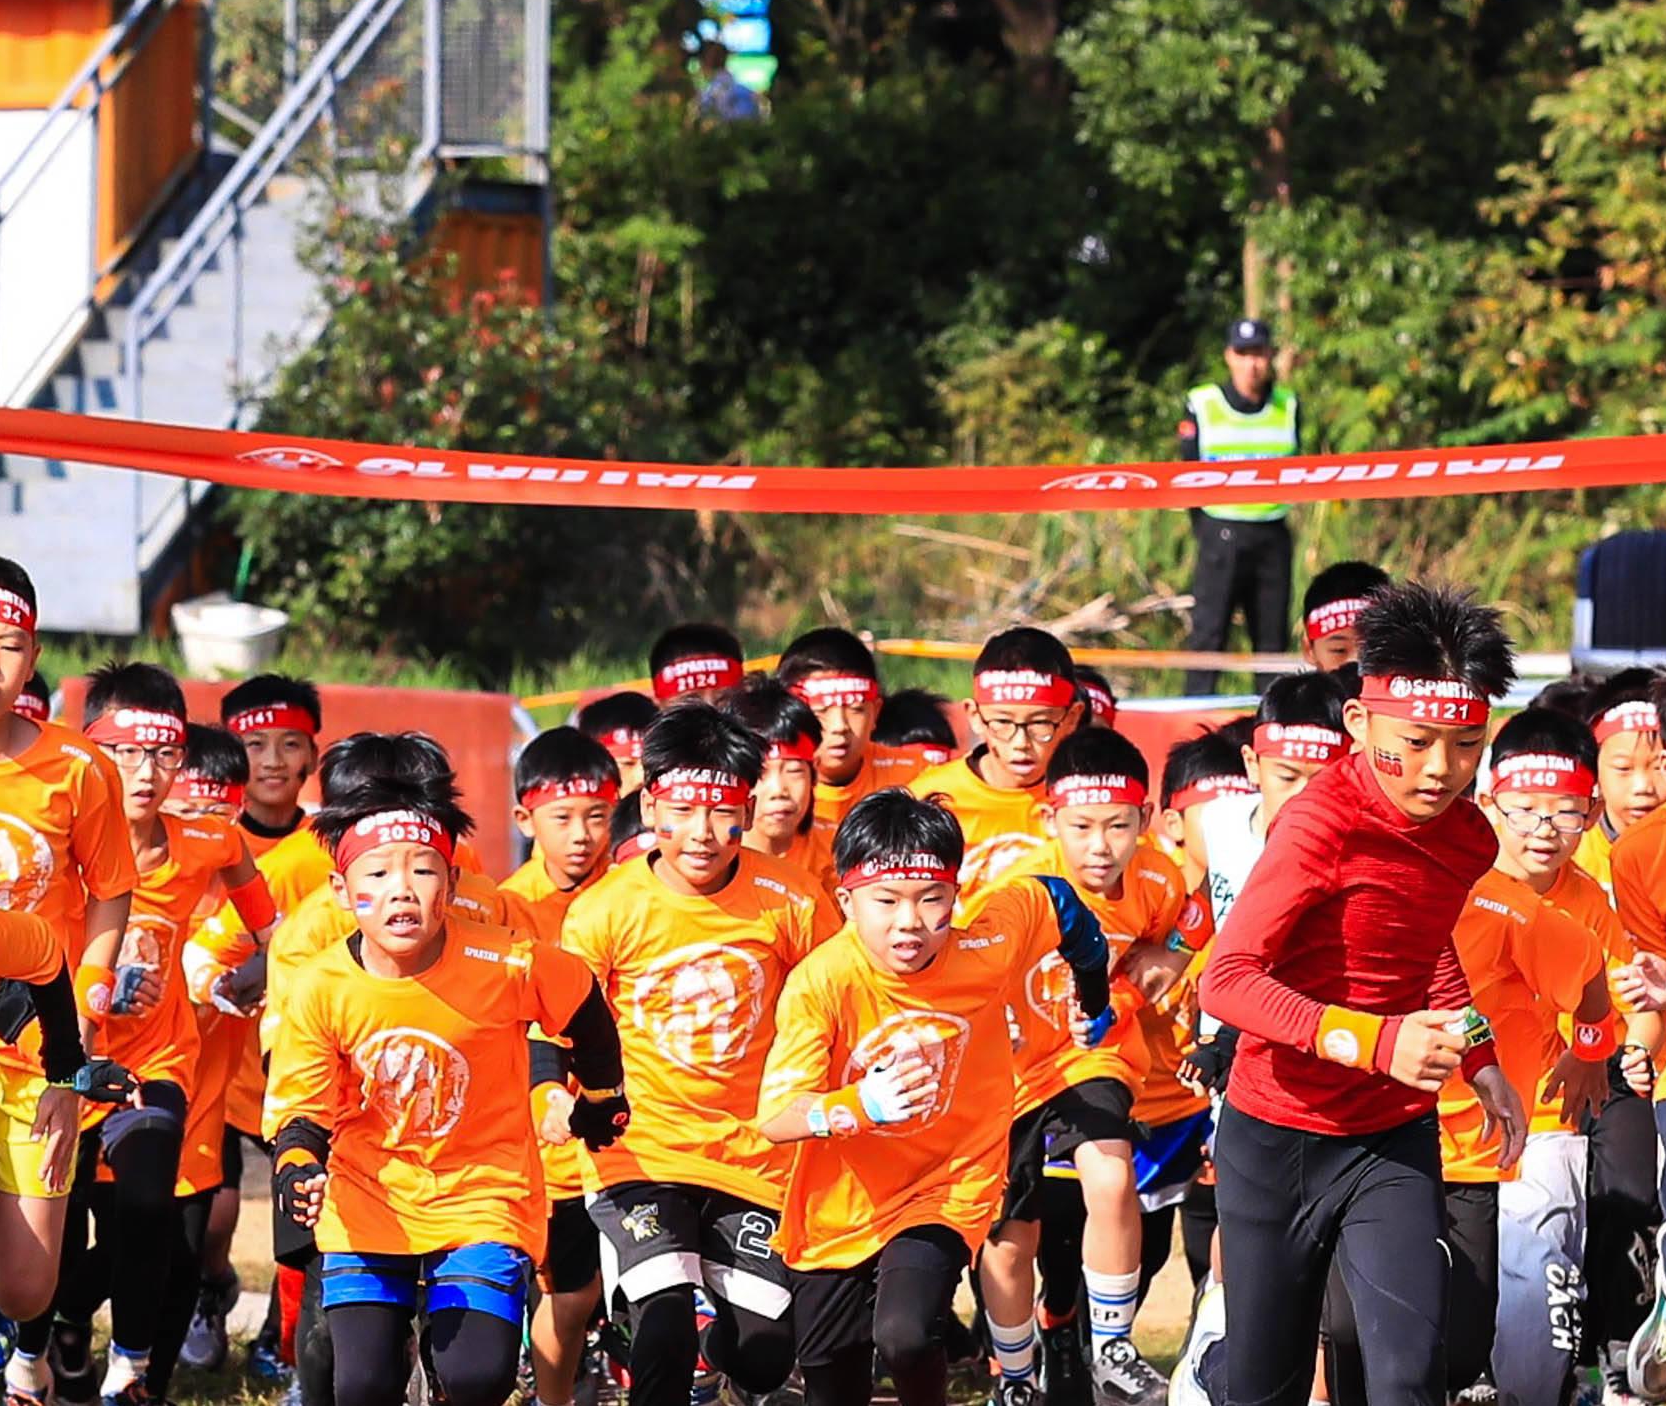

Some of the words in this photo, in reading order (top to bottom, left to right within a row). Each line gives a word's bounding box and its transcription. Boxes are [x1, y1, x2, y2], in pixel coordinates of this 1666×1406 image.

[1411, 700, 1470, 721] 2121
[670, 785, 724, 802] 2015
[376, 825, 431, 844] 2039
